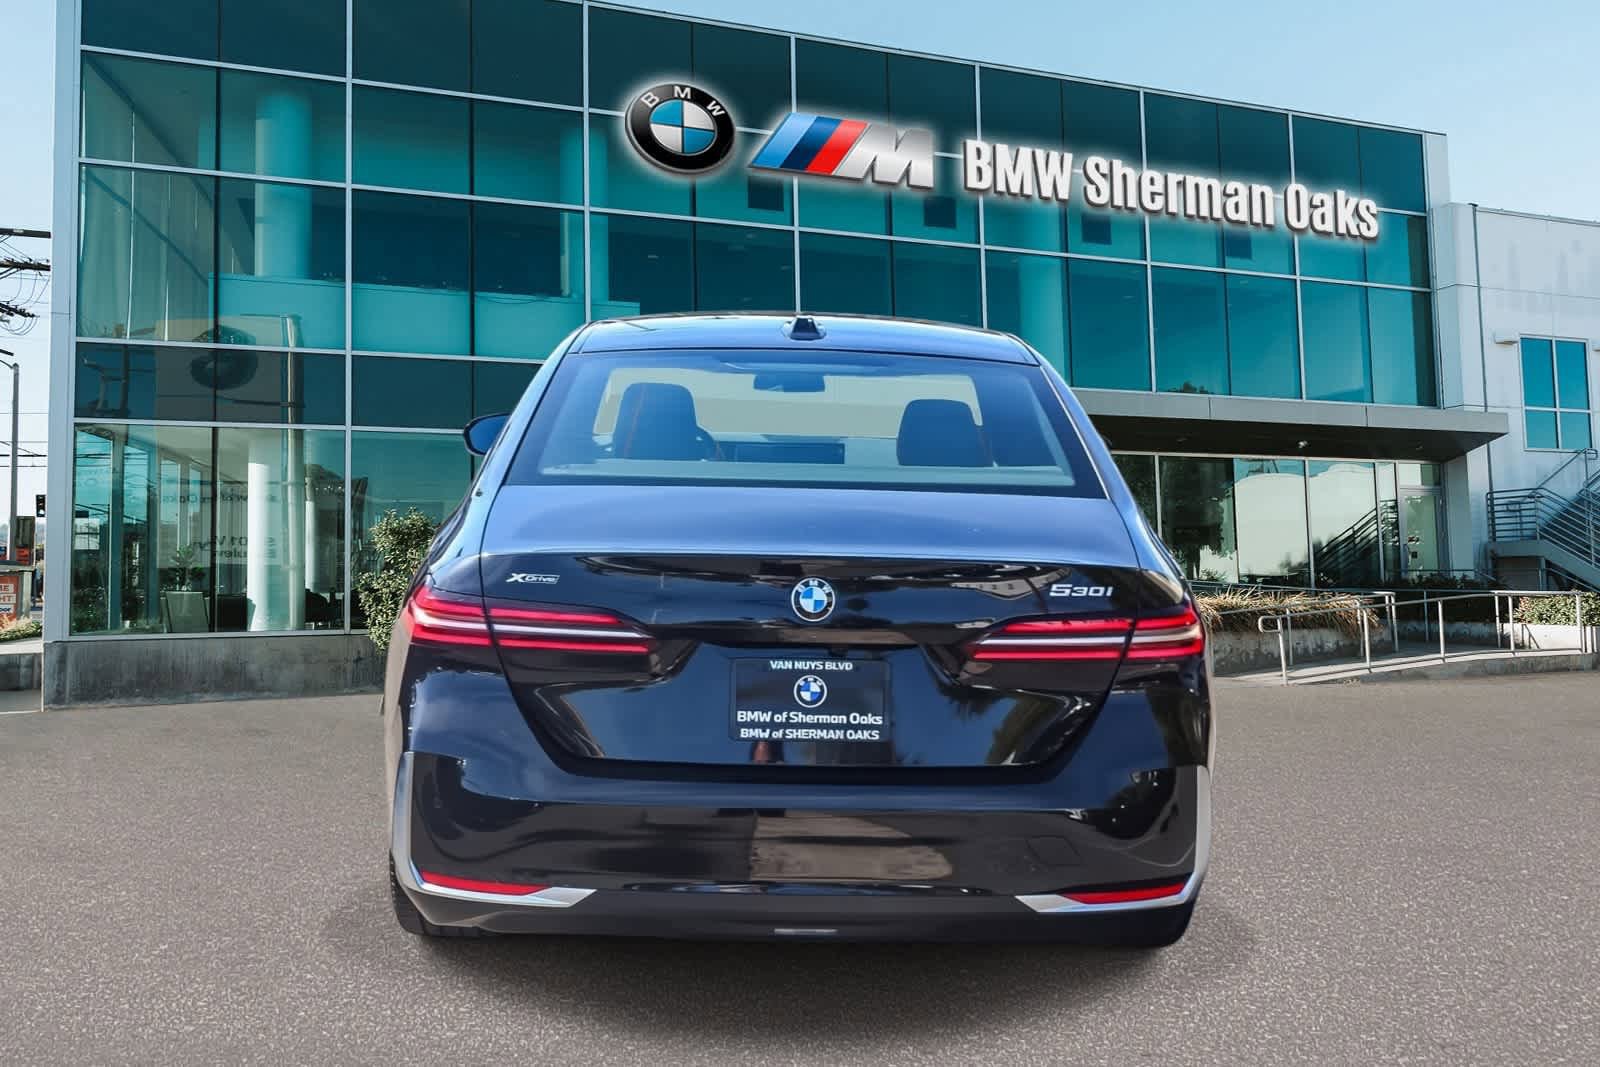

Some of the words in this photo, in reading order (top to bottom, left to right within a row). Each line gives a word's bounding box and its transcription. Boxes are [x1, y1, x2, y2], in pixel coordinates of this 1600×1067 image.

[641, 85, 726, 118] BMW
[963, 138, 1073, 201] BMW
[1083, 154, 1275, 228] Sherman
[1283, 182, 1380, 240] Oaks
[770, 660, 793, 670] VAN
[794, 660, 823, 671] NUYS
[825, 661, 853, 671] BLVD
[736, 710, 772, 723] BMW
[774, 711, 788, 723] of
[789, 712, 847, 725] Sherman
[849, 713, 883, 725] Oaks
[740, 728, 771, 738] BMW
[772, 728, 784, 739] of
[785, 728, 844, 740] SHERMAN
[846, 730, 880, 740] OAKS
